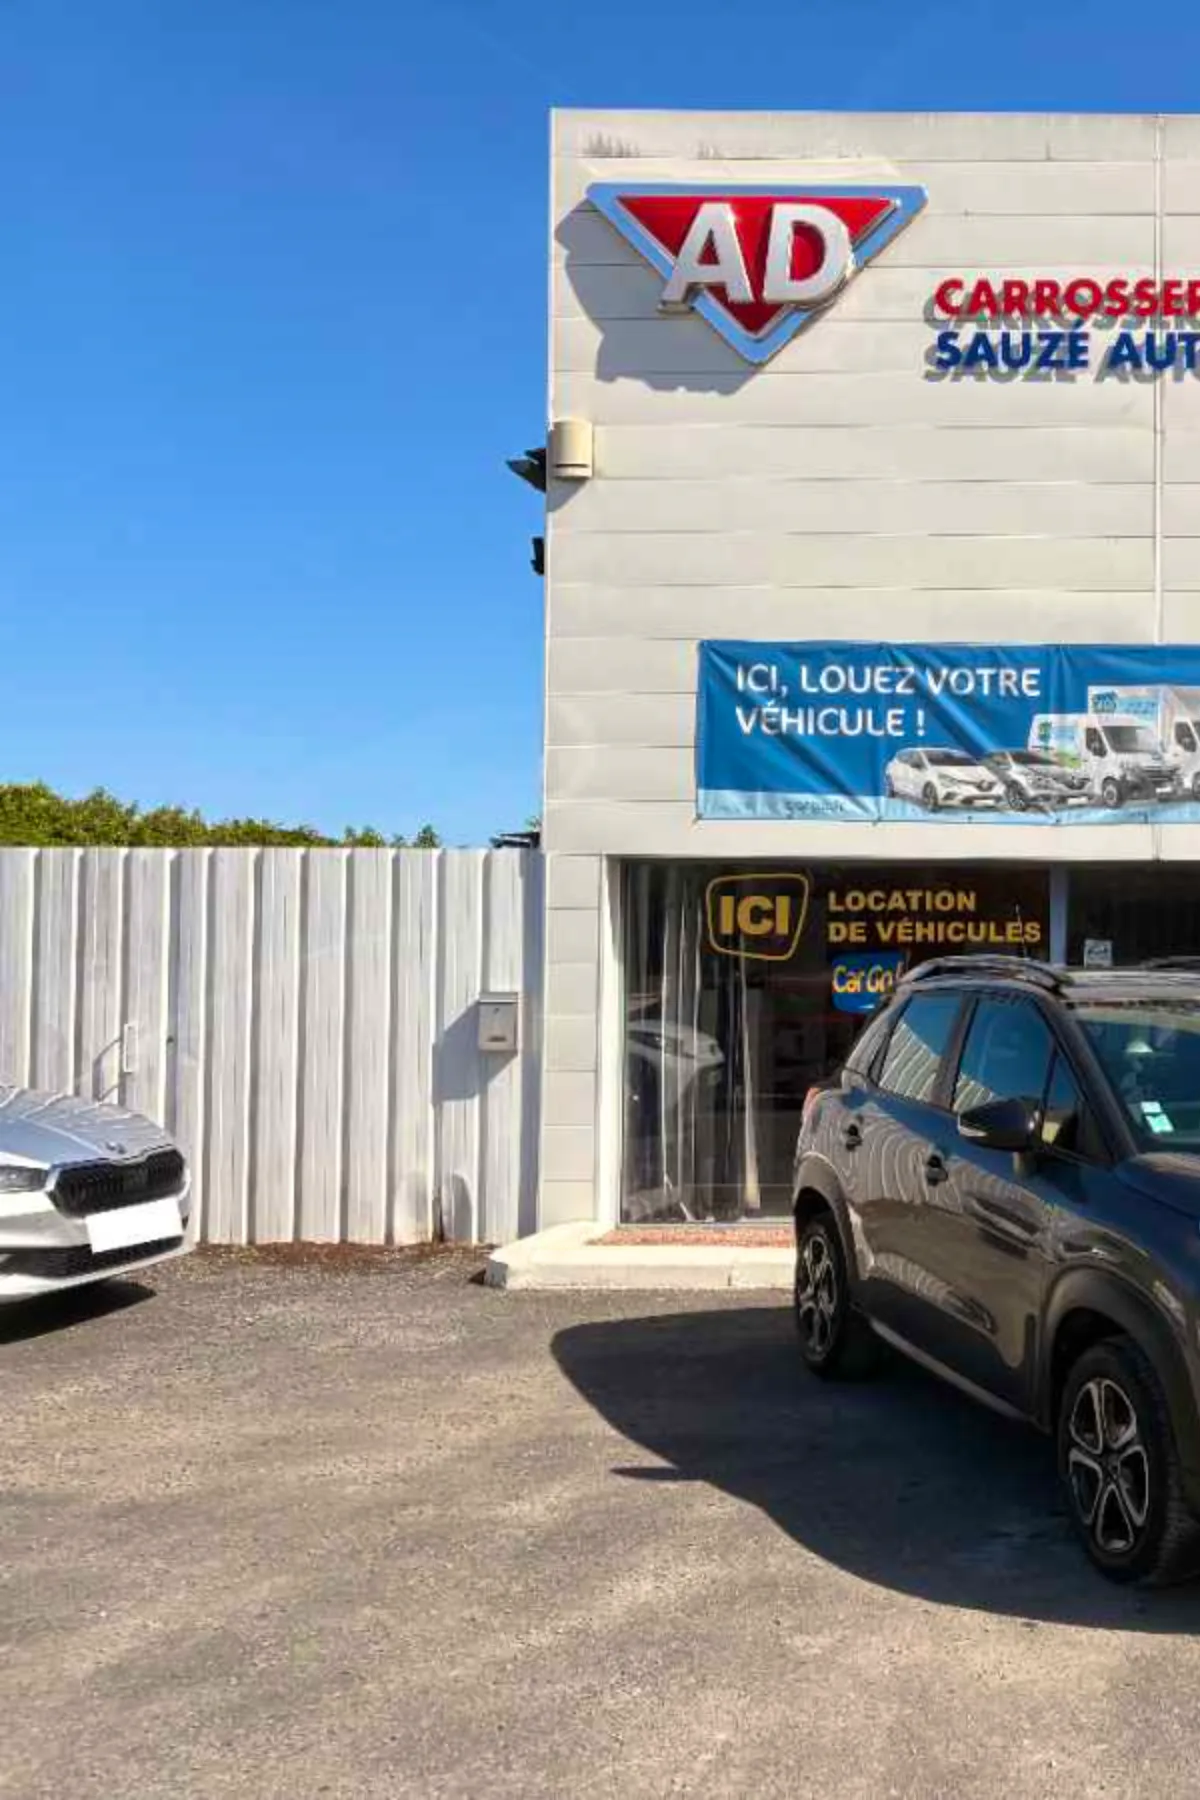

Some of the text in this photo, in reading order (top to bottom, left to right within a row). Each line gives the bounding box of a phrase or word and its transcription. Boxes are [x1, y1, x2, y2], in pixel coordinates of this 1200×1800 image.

[660, 202, 854, 305] AD
[935, 322, 1089, 371] SAUZÉ
[736, 663, 1042, 697] ICI, LOUEZ VOTRE
[735, 699, 905, 737] VÉHICULE
[721, 895, 790, 936] ICI
[829, 890, 976, 912] LOCATION
[828, 918, 1042, 943] DE VÉHICULES
